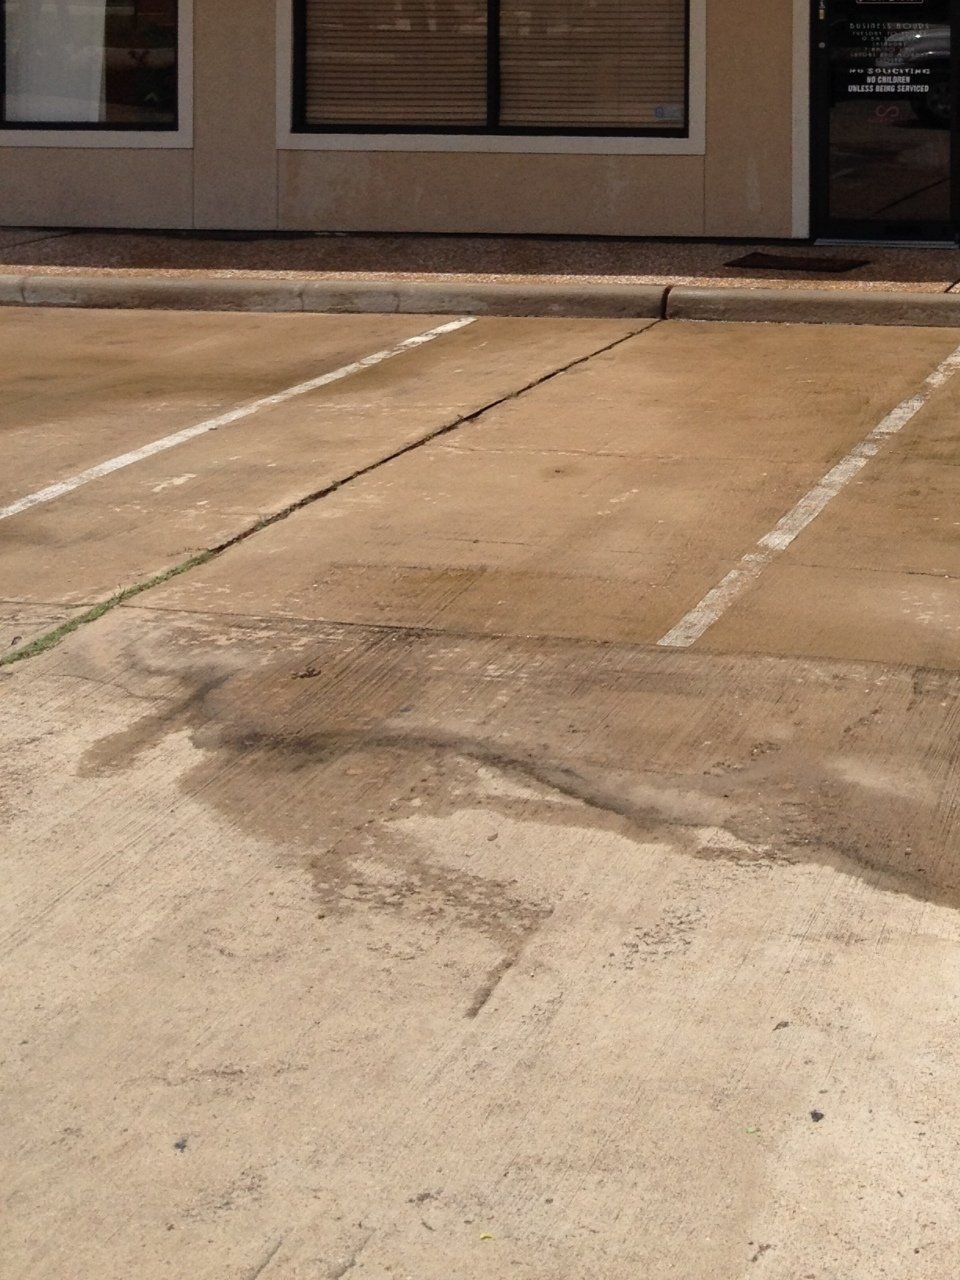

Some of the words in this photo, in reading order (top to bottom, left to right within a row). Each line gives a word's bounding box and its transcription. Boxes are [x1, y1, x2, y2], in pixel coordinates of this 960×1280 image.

[867, 67, 931, 75] SOLICITING
[877, 76, 911, 84] CHILDREN
[848, 84, 874, 92] UNLESS
[897, 84, 930, 92] SERVICED
